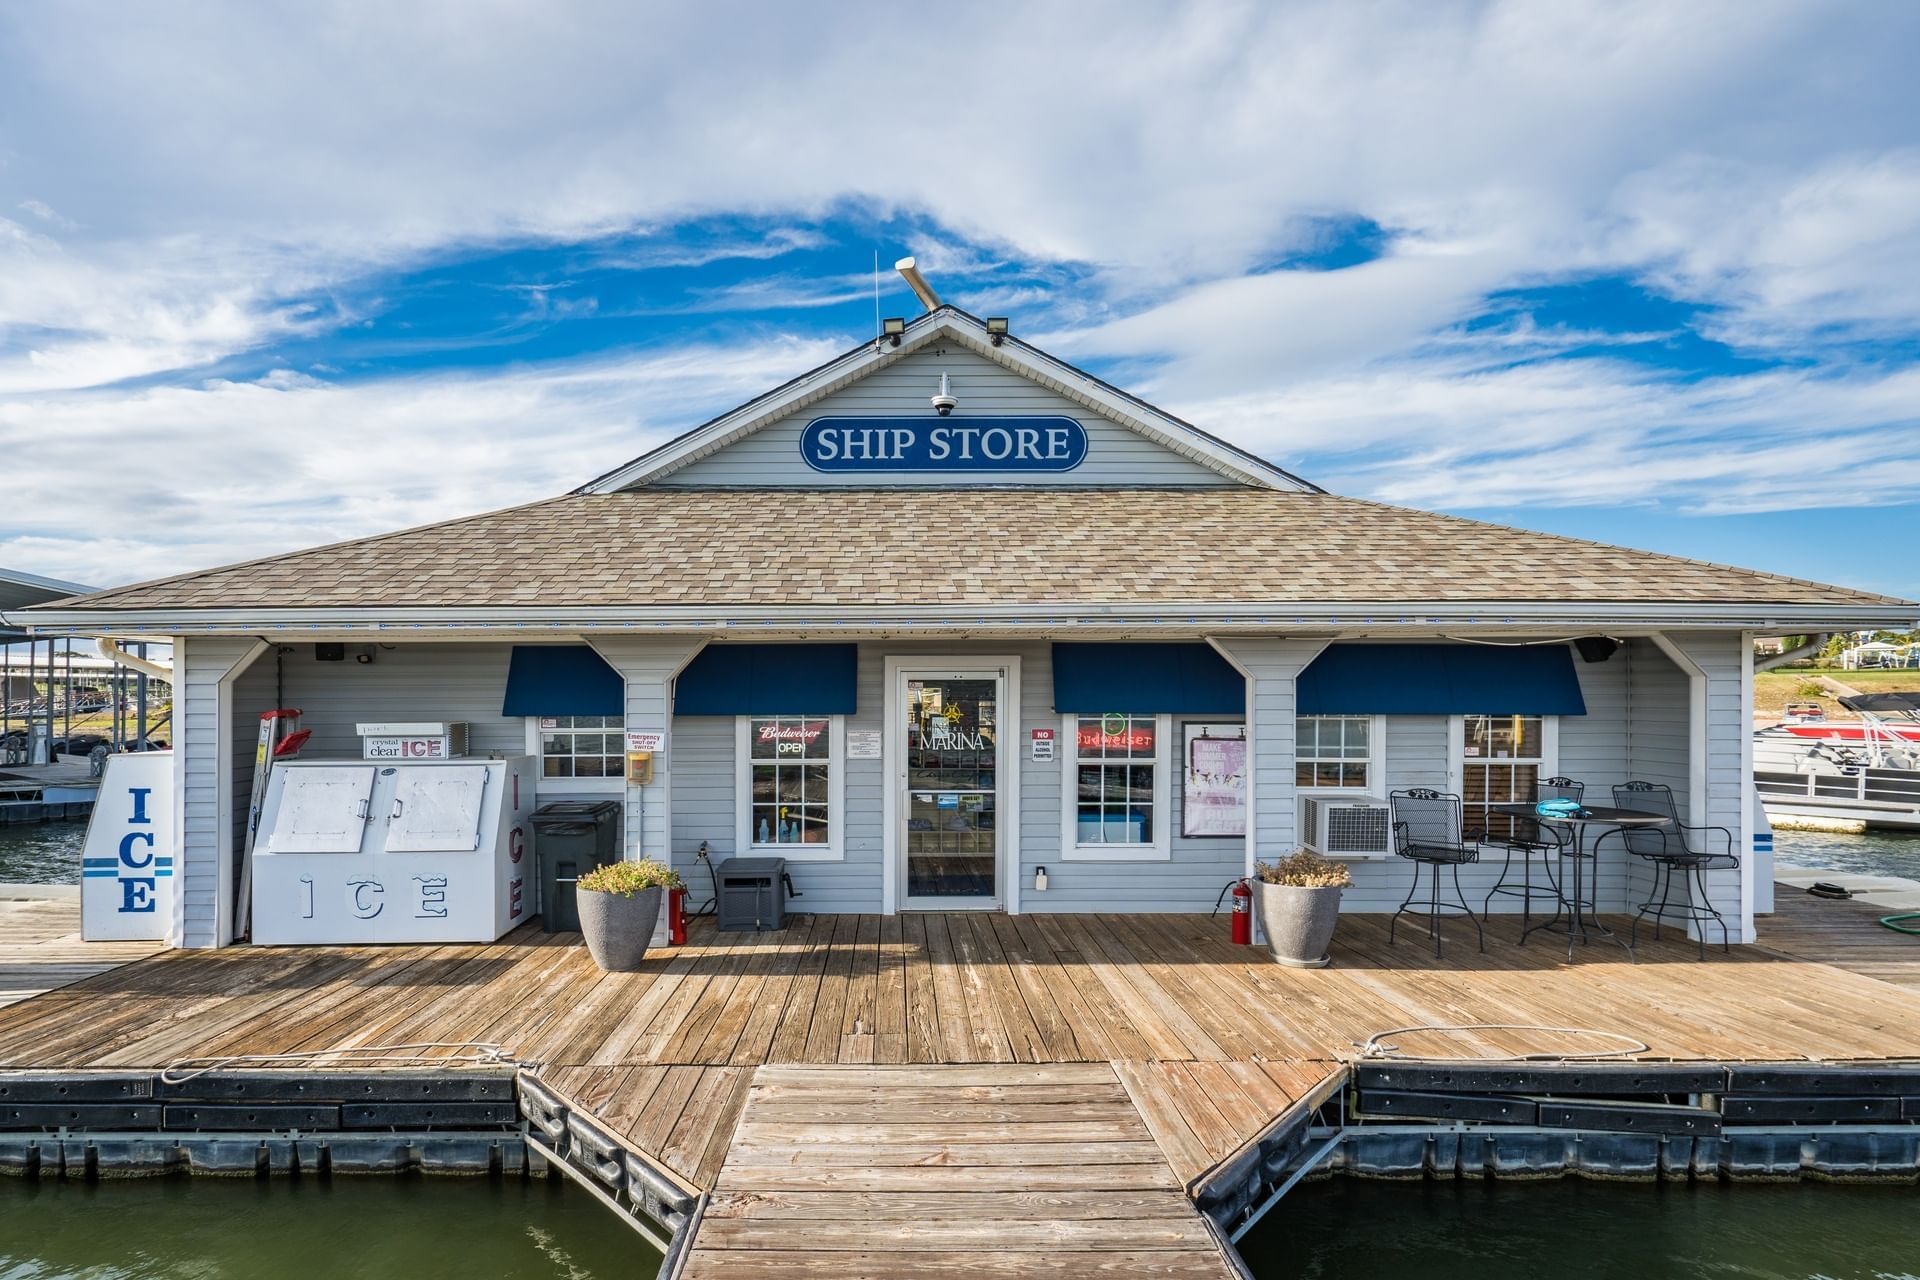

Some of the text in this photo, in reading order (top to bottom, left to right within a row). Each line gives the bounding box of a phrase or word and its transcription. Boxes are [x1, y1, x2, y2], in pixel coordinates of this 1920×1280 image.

[817, 428, 1071, 460] SHIP STORE
[627, 733, 661, 741] Emergency
[760, 726, 820, 739] Budweiser
[1076, 732, 1153, 746] Budweiser
[372, 738, 399, 746] crystal
[401, 740, 442, 757] ICE
[778, 743, 806, 753] OPEN
[920, 732, 985, 750] MARINA
[370, 746, 400, 757] clear
[118, 788, 156, 913] ICE
[508, 768, 524, 920] ICE
[299, 873, 448, 919] ICE
